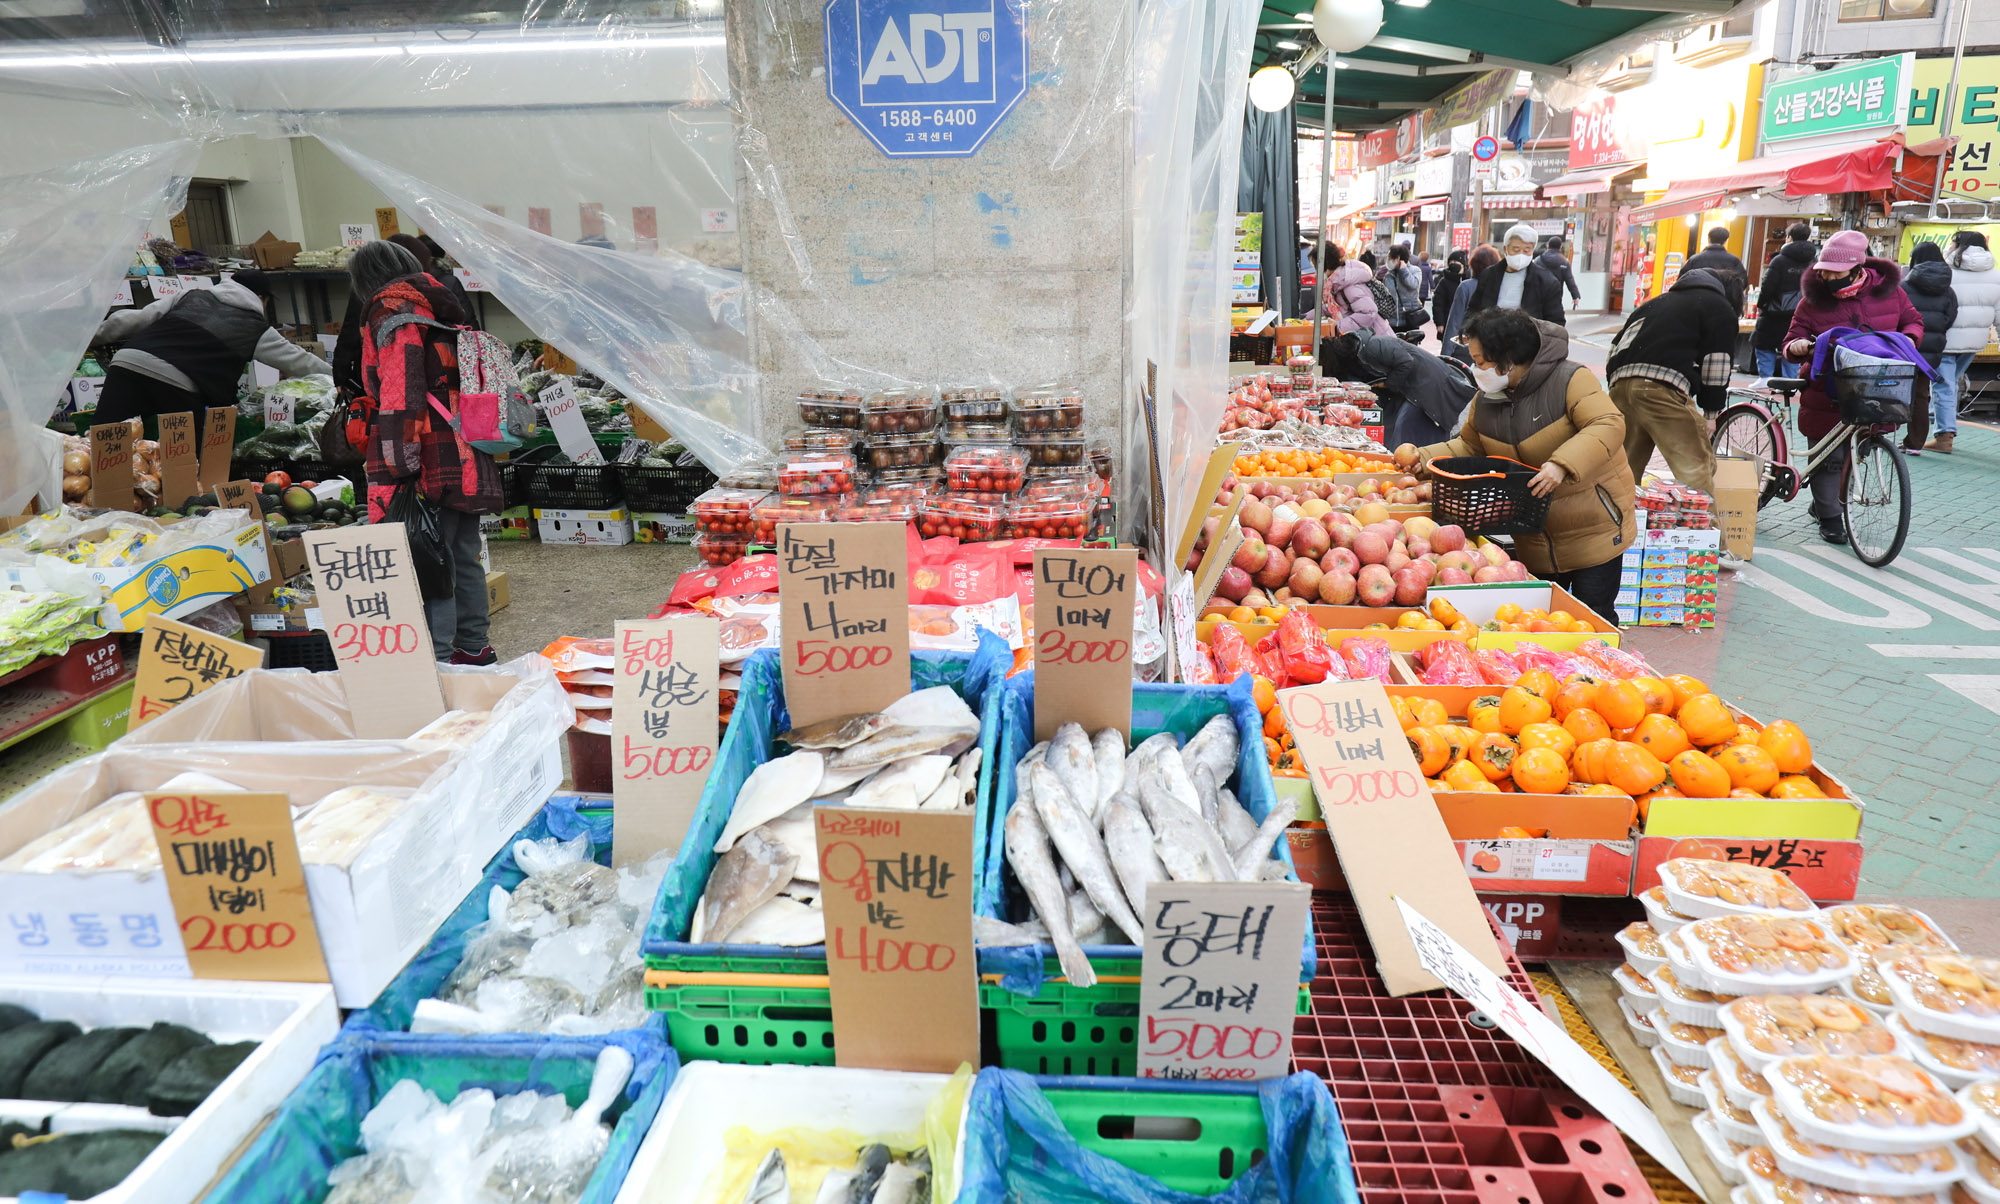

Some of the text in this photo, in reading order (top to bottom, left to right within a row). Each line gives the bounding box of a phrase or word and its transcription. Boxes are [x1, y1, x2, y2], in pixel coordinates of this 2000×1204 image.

[1774, 75, 1886, 125] 산들건강식품
[879, 108, 977, 128] 1588-6400
[904, 131, 953, 143] 고객센터
[147, 567, 171, 596] Chiquita
[311, 541, 400, 592] 동태포
[804, 565, 896, 596] 가자미
[1042, 557, 1126, 599] 민어
[85, 643, 118, 667] KPP
[622, 628, 674, 677] 통영
[819, 812, 901, 838] 노르웨이
[1541, 849, 1553, 859] 27
[1484, 902, 1545, 924] KPP
[180, 914, 297, 955] 2000
[1151, 899, 1275, 968] 동태
[1158, 973, 1259, 1015] 2마리
